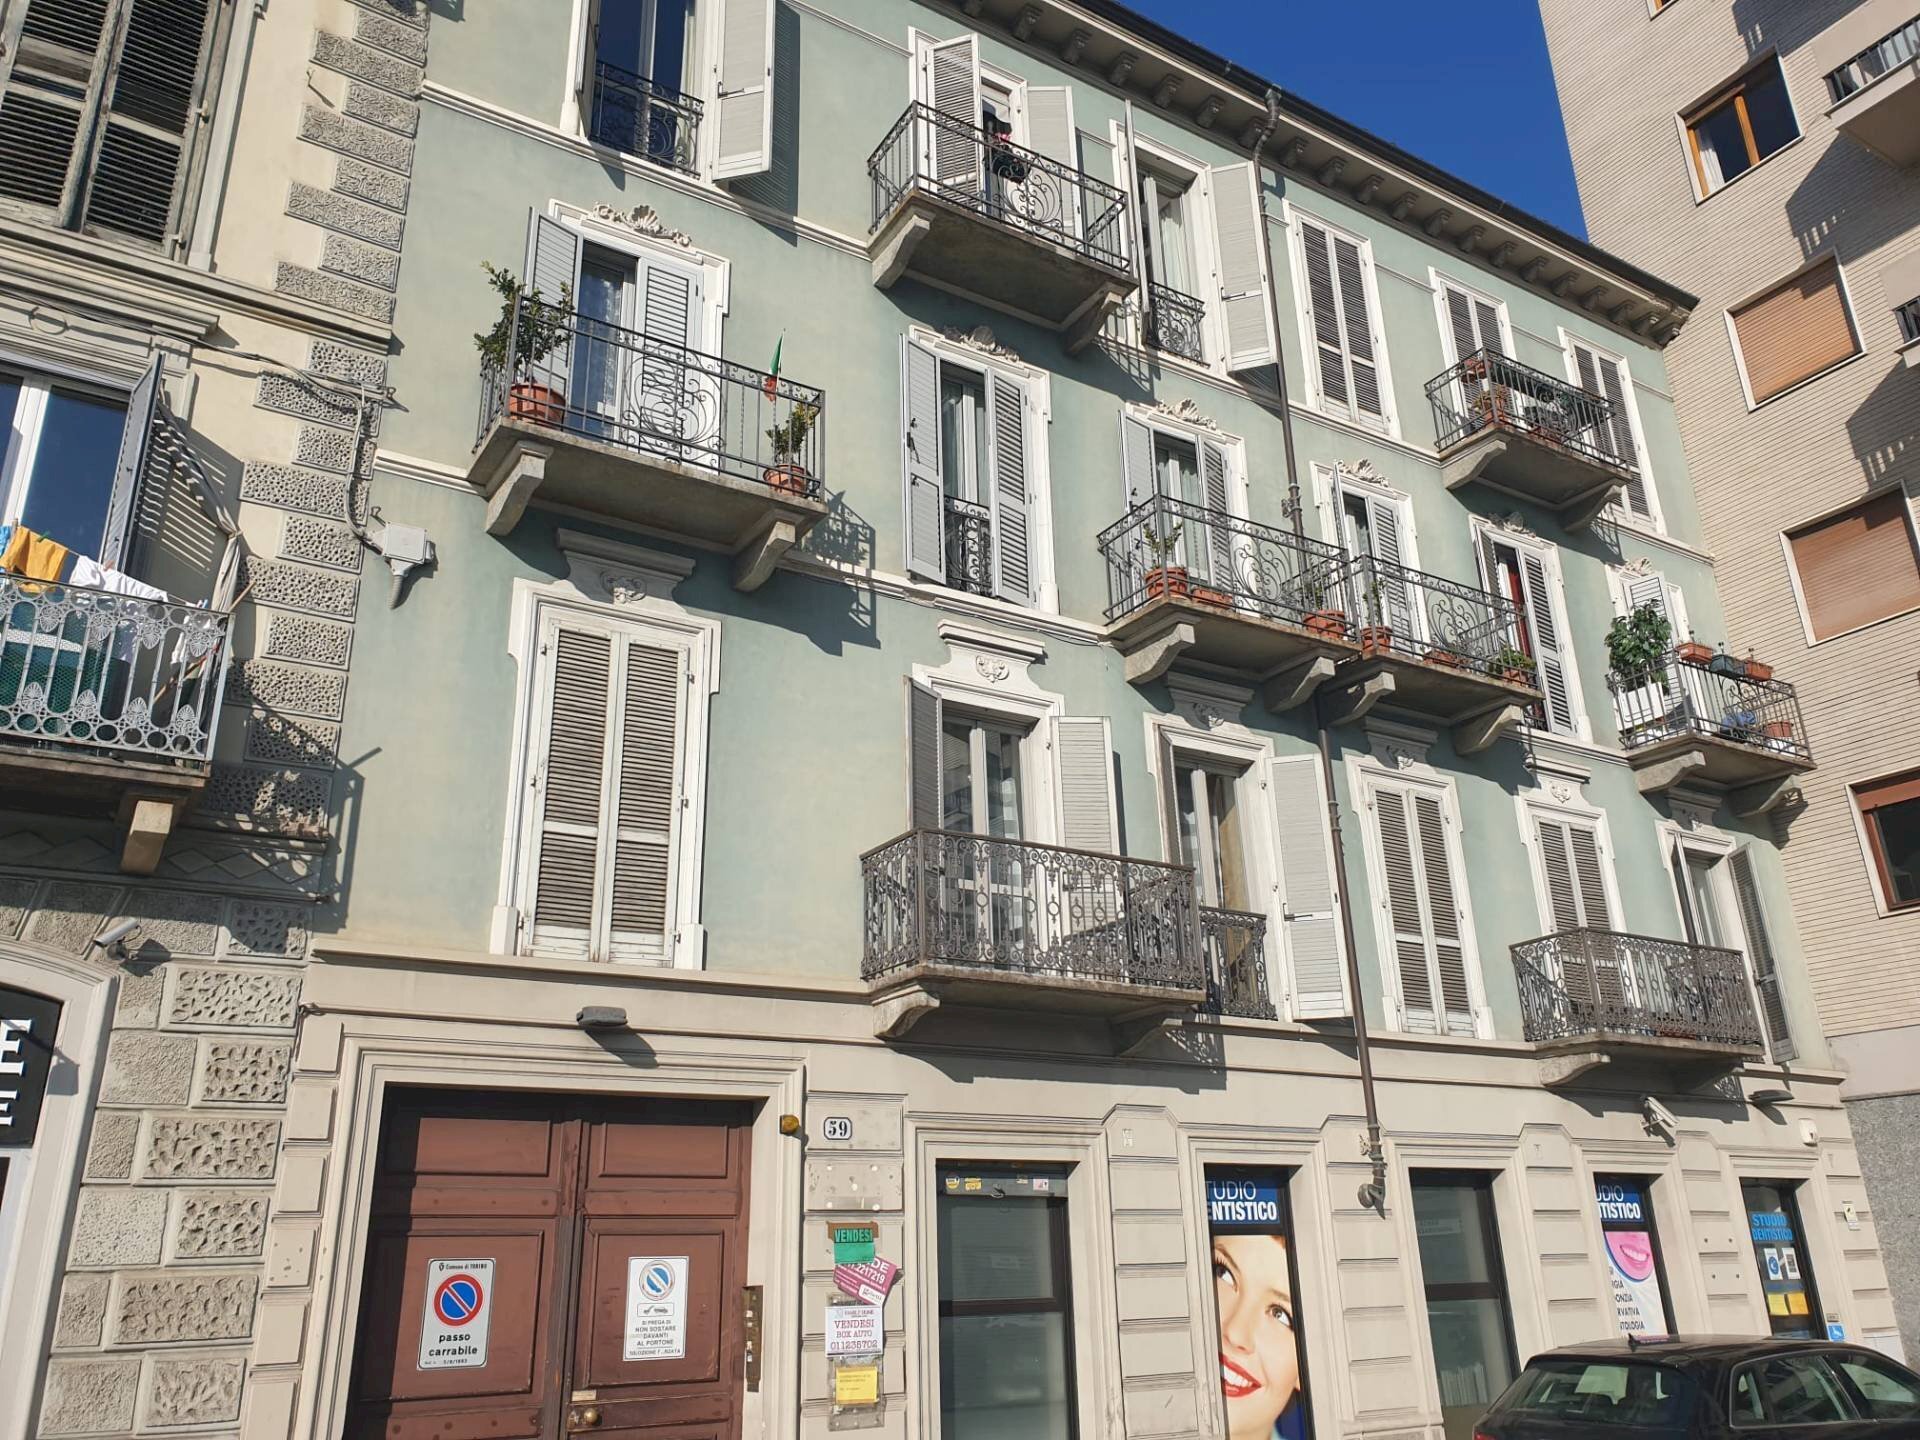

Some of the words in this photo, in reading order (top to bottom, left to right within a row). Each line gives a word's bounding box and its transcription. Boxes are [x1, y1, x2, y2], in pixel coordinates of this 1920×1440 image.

[0, 1020, 32, 1076] E
[829, 1121, 848, 1137] 59
[1752, 1213, 1786, 1226] STUDIO
[834, 1228, 874, 1243] VENDESI
[1752, 1228, 1793, 1241] DENTISTICO
[834, 1319, 875, 1329] VENDESI
[438, 1333, 471, 1344] passo
[836, 1330, 852, 1339] BOX
[853, 1330, 873, 1338] AUTO
[428, 1346, 478, 1357] carrabile
